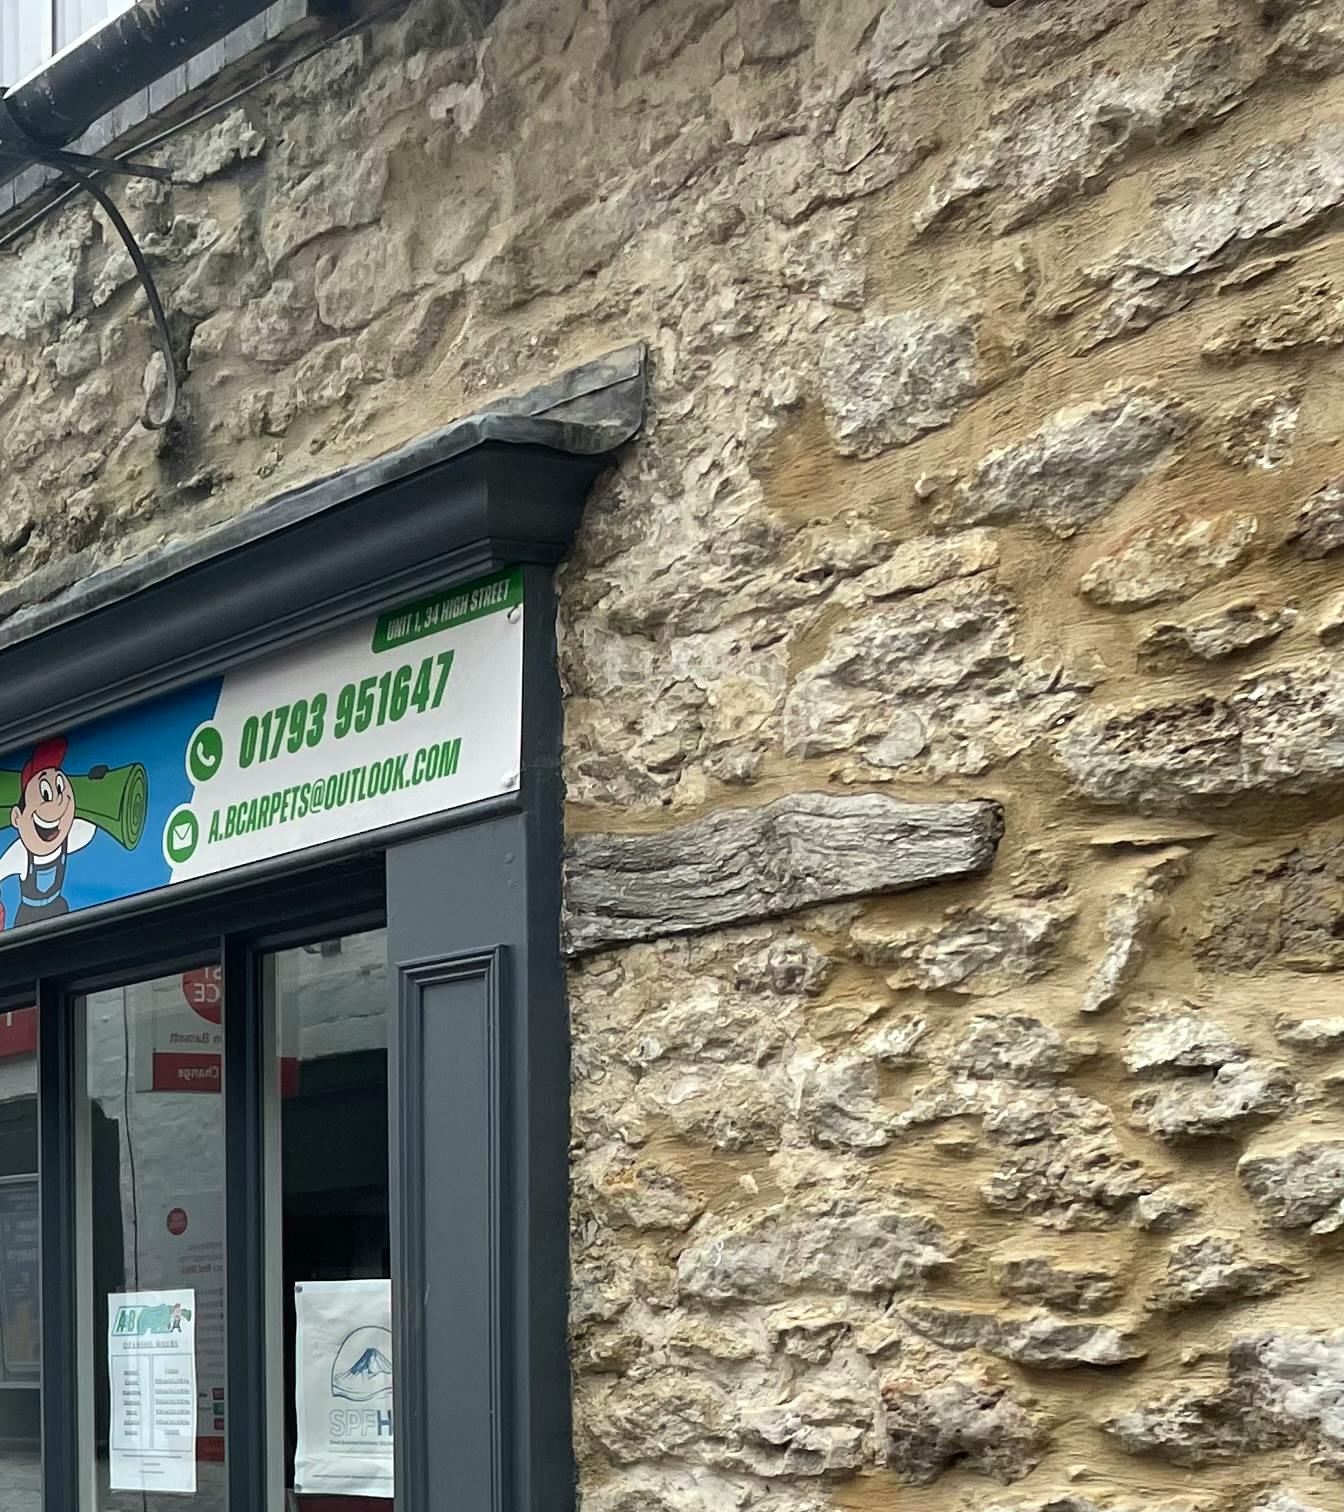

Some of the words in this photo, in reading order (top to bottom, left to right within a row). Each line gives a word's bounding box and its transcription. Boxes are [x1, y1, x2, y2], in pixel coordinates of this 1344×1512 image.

[386, 618, 413, 641] UNIT
[424, 607, 440, 629] 34
[441, 595, 470, 622] HIGH
[470, 578, 511, 615] STREET
[238, 692, 328, 769] 01793
[333, 649, 455, 740] 951647
[207, 737, 462, 845] A.BCARPETS@OUTLOOK.COM
